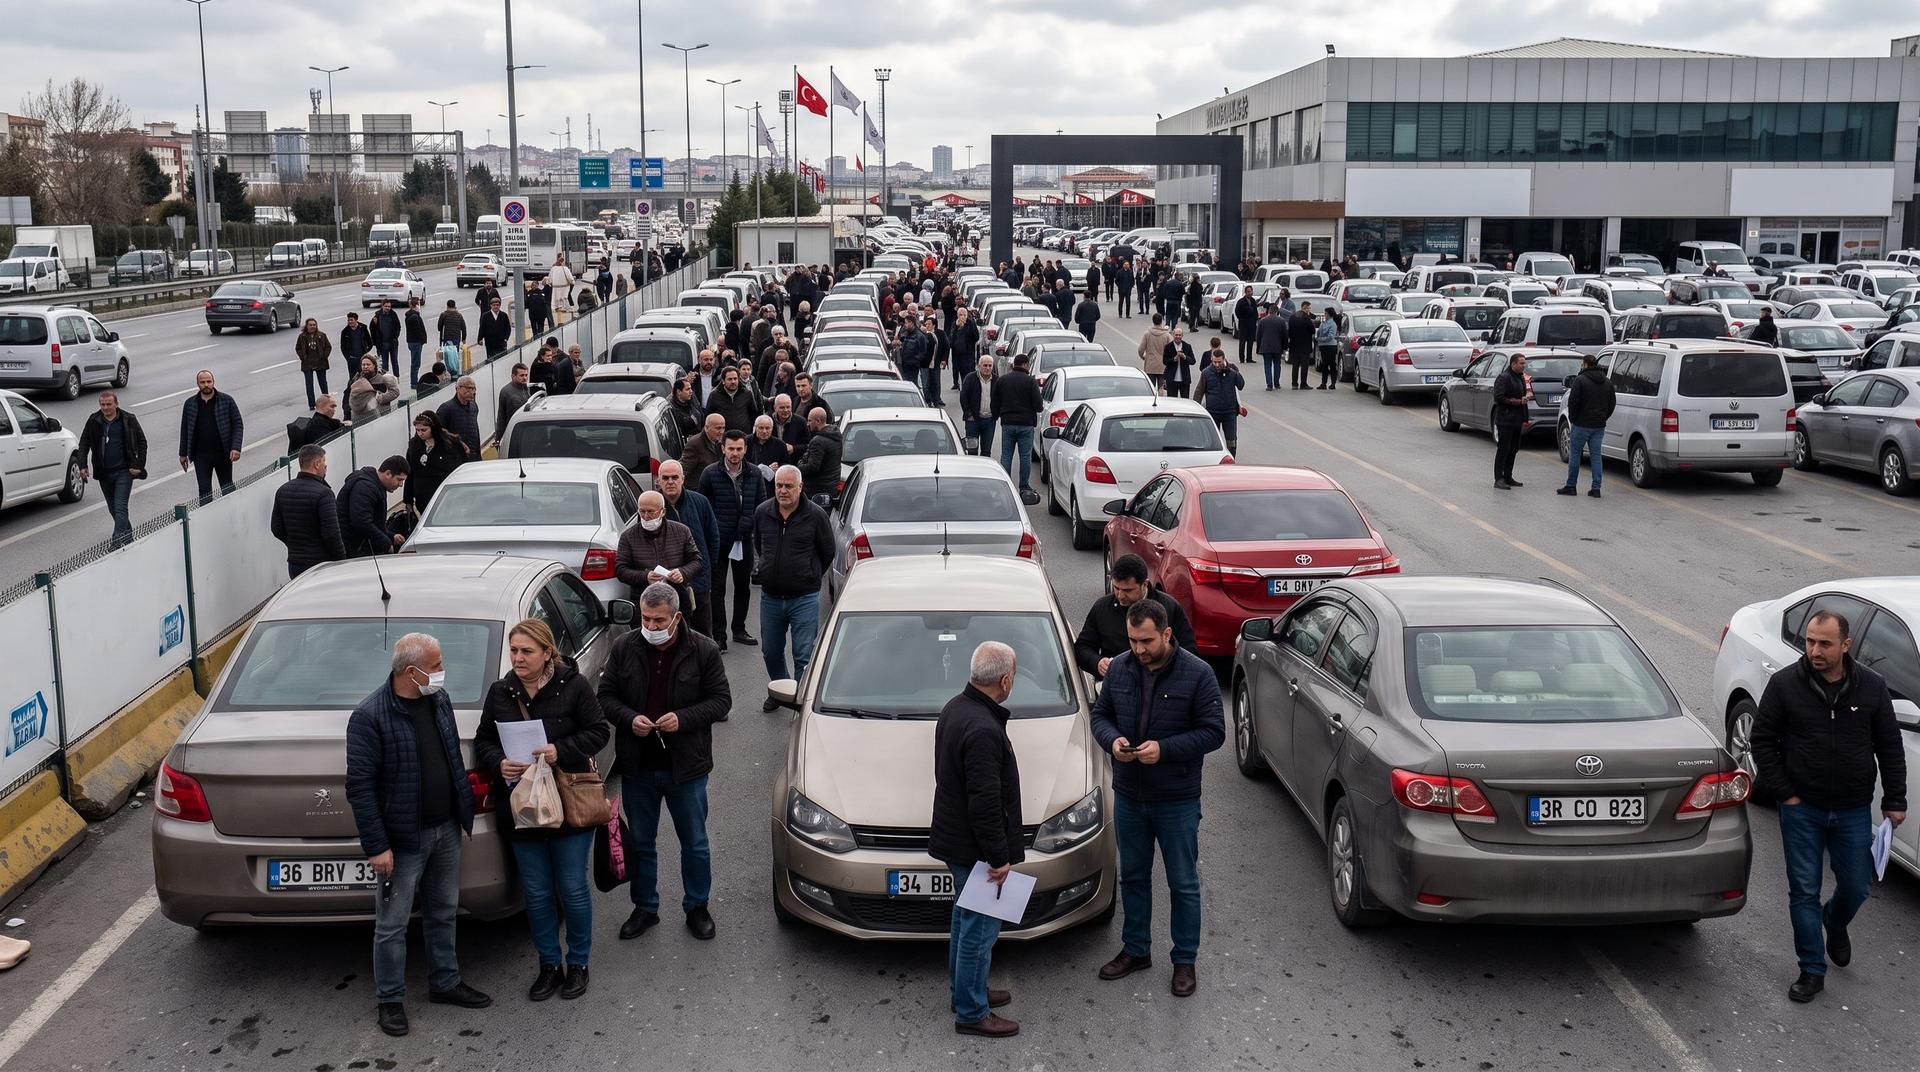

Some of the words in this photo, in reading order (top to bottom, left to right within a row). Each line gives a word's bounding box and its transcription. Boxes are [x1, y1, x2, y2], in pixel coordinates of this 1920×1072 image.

[1275, 580, 1288, 592] 54
[1609, 799, 1642, 818] 823
[280, 863, 302, 883] 36
[312, 862, 346, 882] BRV
[899, 874, 921, 893] 34
[931, 874, 953, 893] BB
